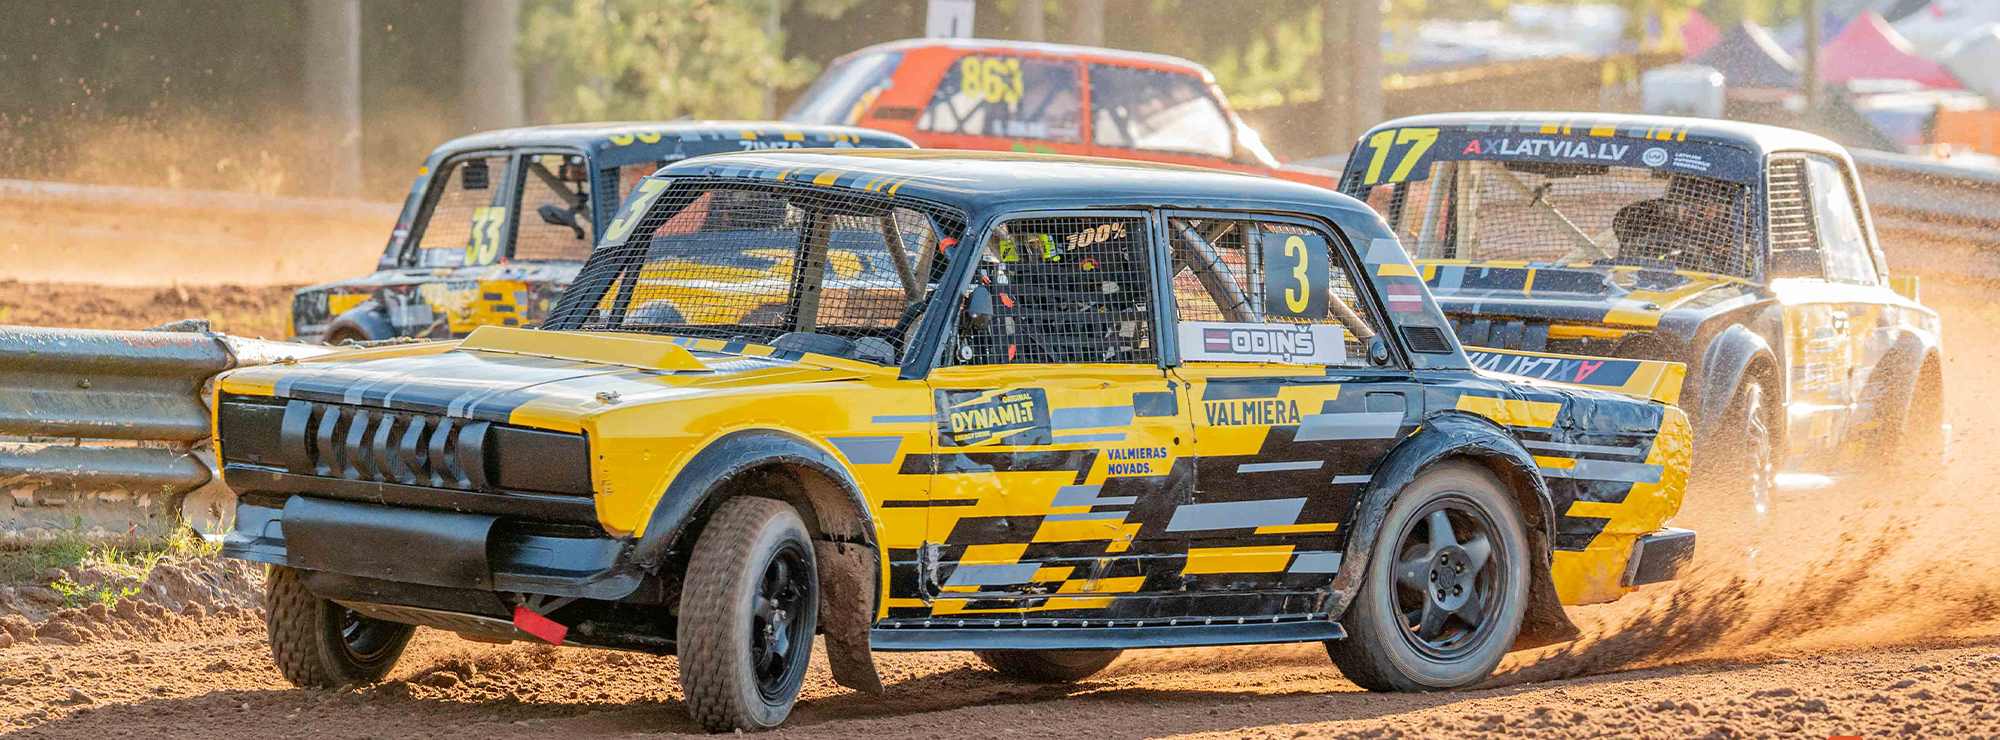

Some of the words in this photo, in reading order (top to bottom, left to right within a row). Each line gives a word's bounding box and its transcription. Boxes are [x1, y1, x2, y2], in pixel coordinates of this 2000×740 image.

[1364, 128, 1441, 185] 17
[1462, 138, 1629, 161] AXLATVIA.LV
[607, 178, 670, 241] 3
[464, 206, 506, 266] 33
[1066, 222, 1126, 251] 100%
[1284, 235, 1310, 314] 3
[1231, 324, 1315, 362] ODIŅŠ
[1002, 392, 1032, 404] ORIGINAL
[1204, 400, 1301, 426] VALMIERA
[1107, 446, 1167, 460] VALMIERAS
[1108, 462, 1154, 475] NOVADS.
